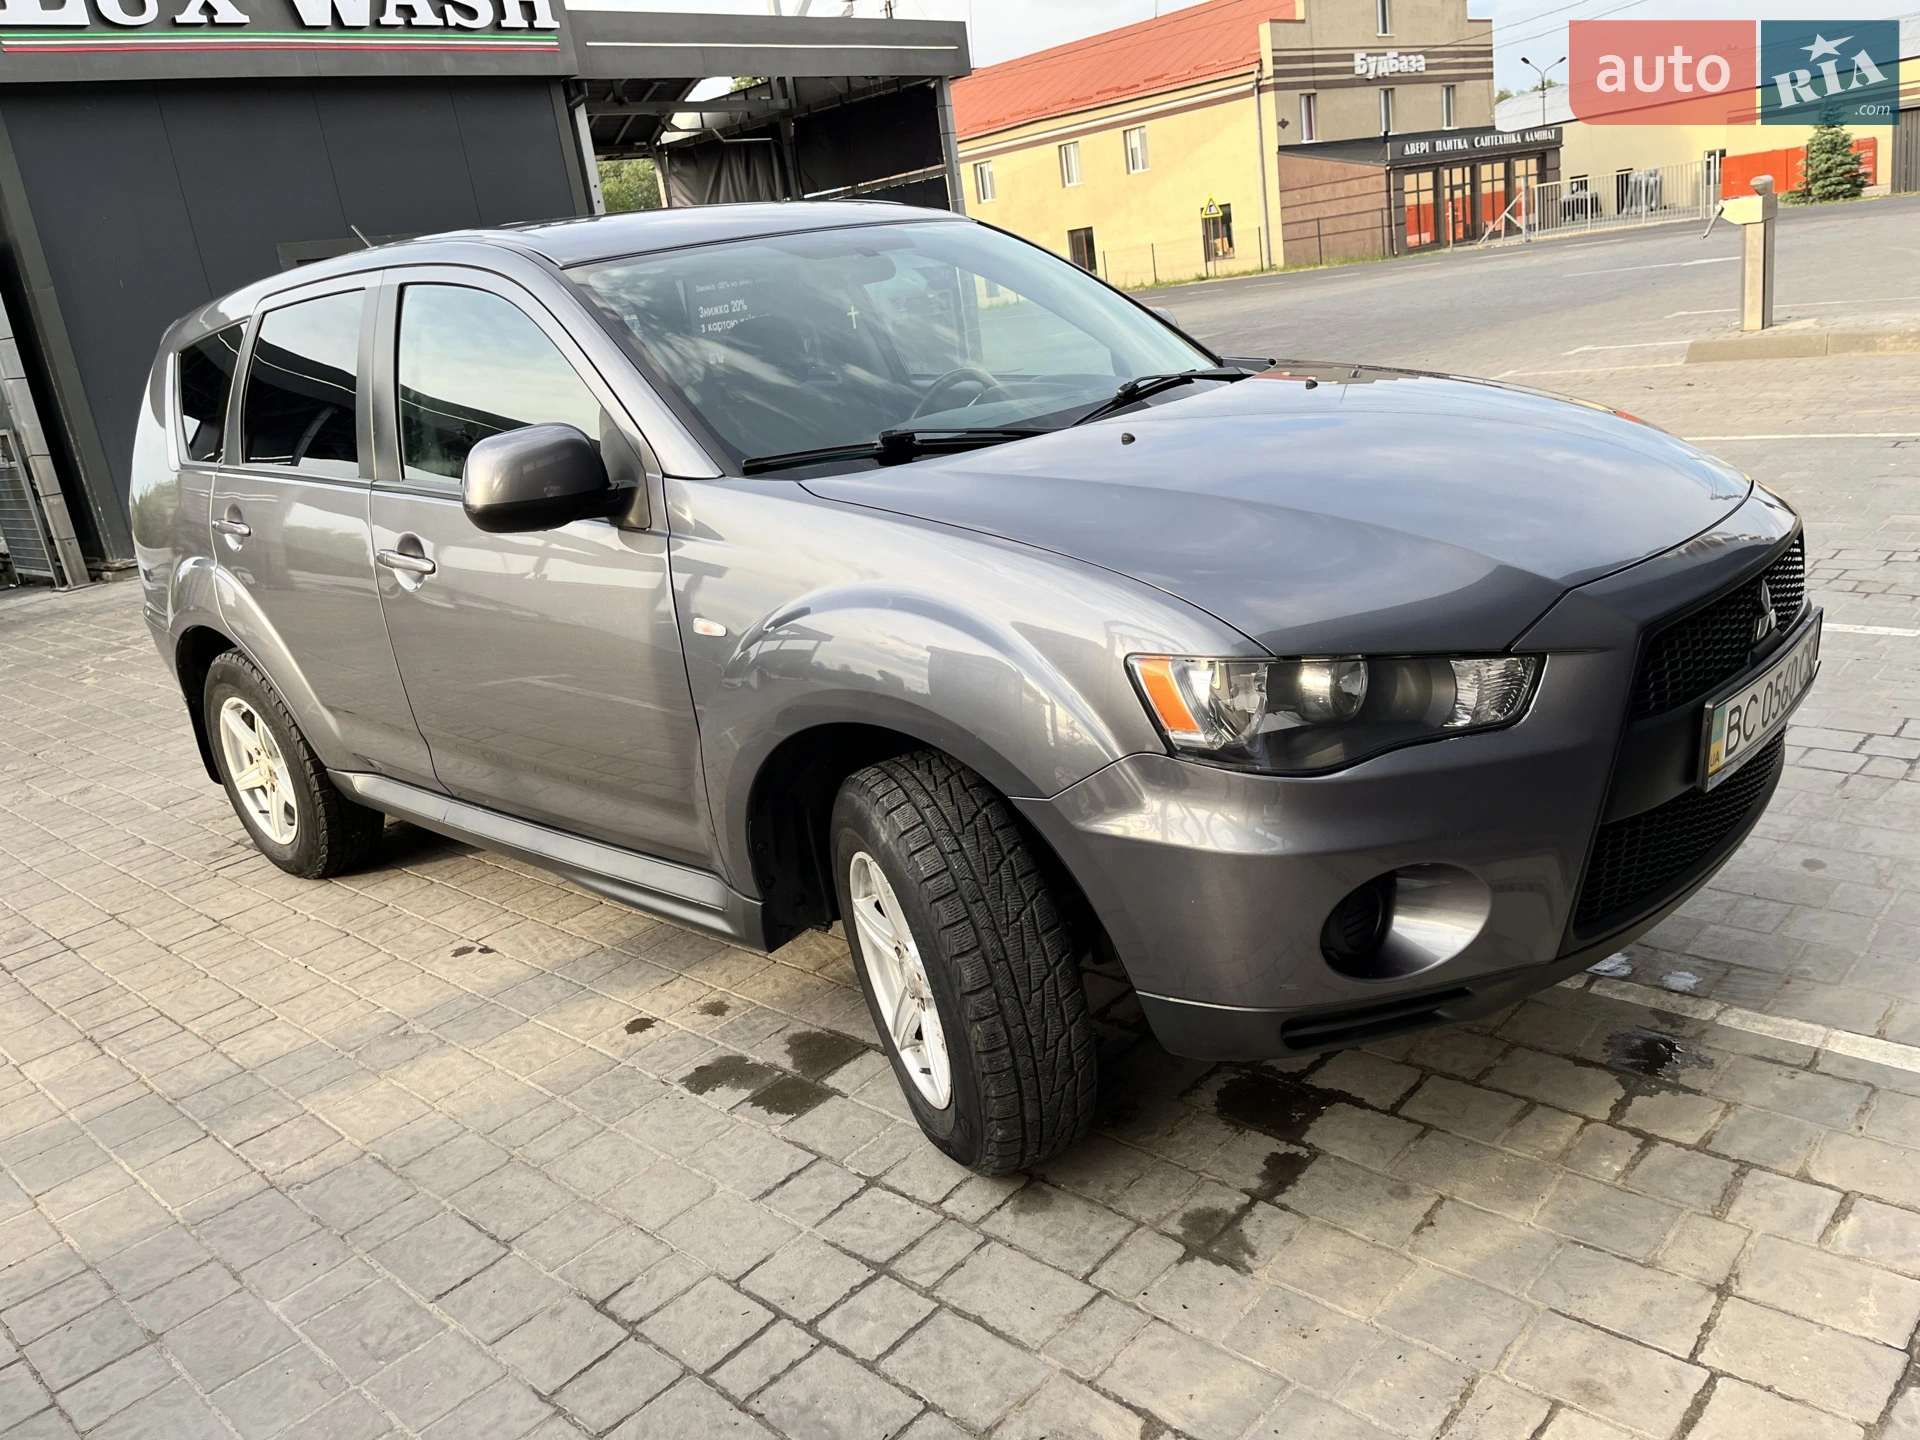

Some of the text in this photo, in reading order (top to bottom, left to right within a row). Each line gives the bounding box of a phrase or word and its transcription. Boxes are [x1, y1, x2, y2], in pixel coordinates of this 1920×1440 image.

[1354, 52, 1426, 79] БудБаза
[1403, 141, 1429, 155] ДВЕРІ
[1474, 133, 1522, 148] САНТЕХНІКА
[699, 303, 729, 318] Знижка
[730, 299, 748, 312] 20%
[1725, 693, 1759, 758] BC
[1761, 655, 1799, 728] 0560
